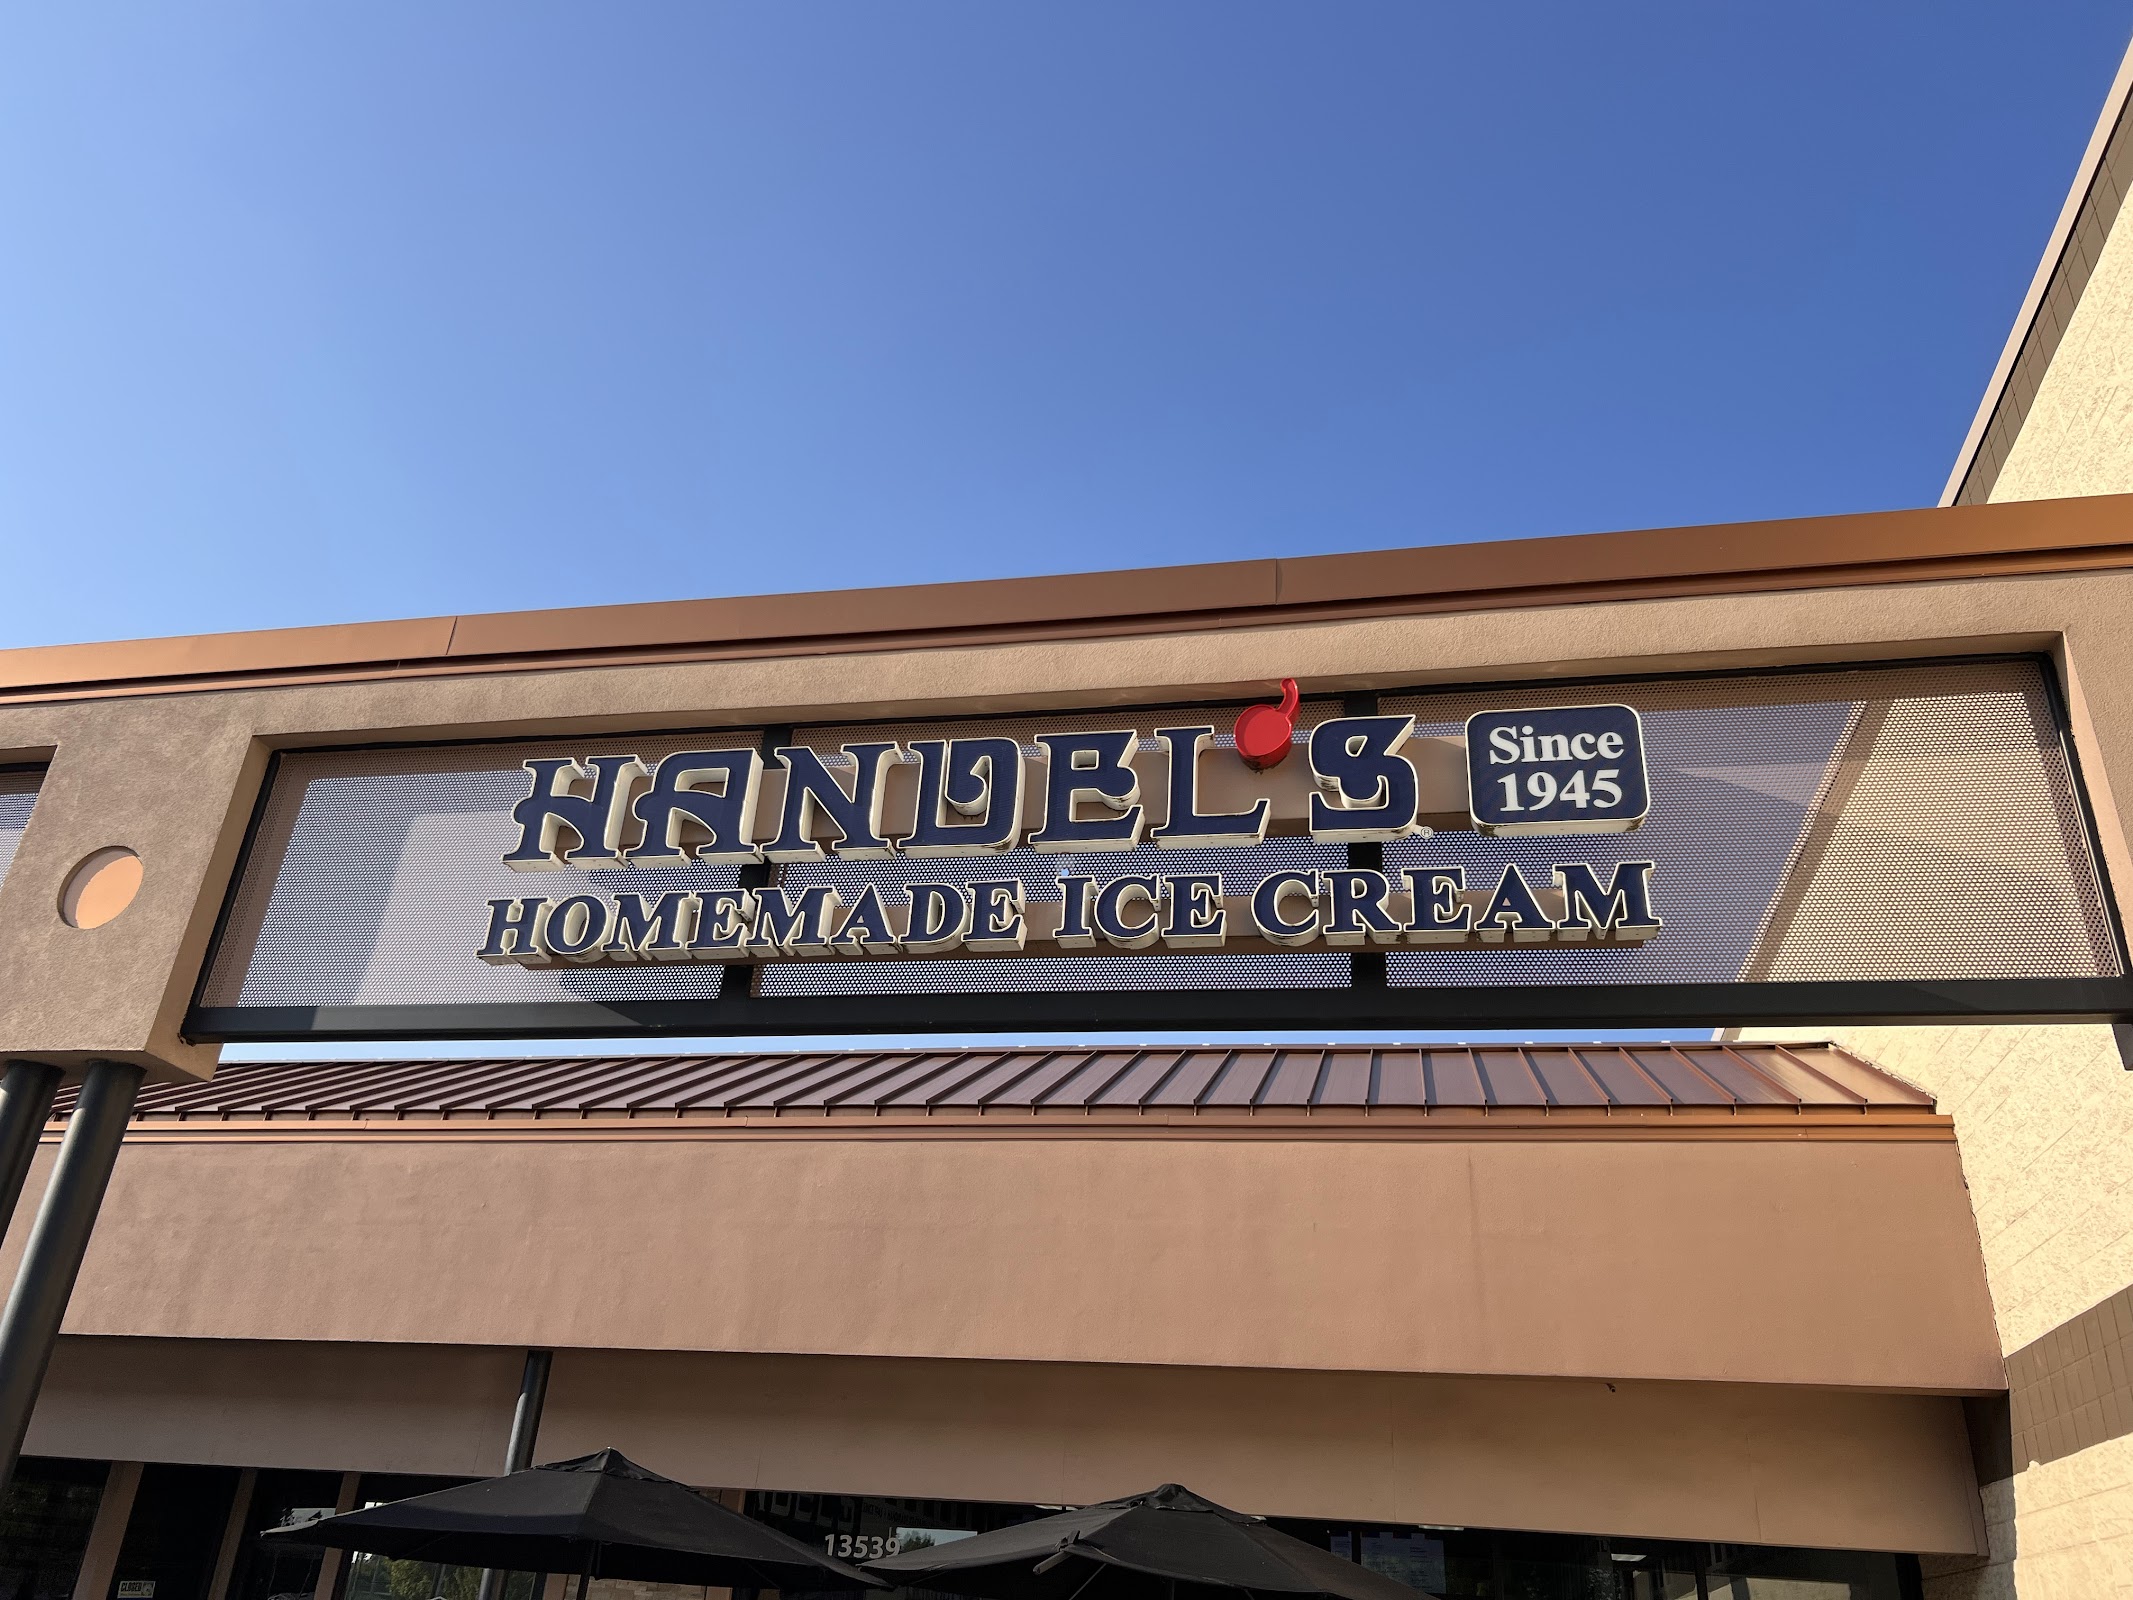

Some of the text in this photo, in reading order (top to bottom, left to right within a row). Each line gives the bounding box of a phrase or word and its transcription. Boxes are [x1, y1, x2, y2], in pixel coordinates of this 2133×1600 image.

[1489, 725, 1625, 764] Since
[1497, 769, 1622, 811] 1945
[476, 861, 1663, 962] HOMEMADE ICE CREAM
[825, 1534, 900, 1559] 13539
